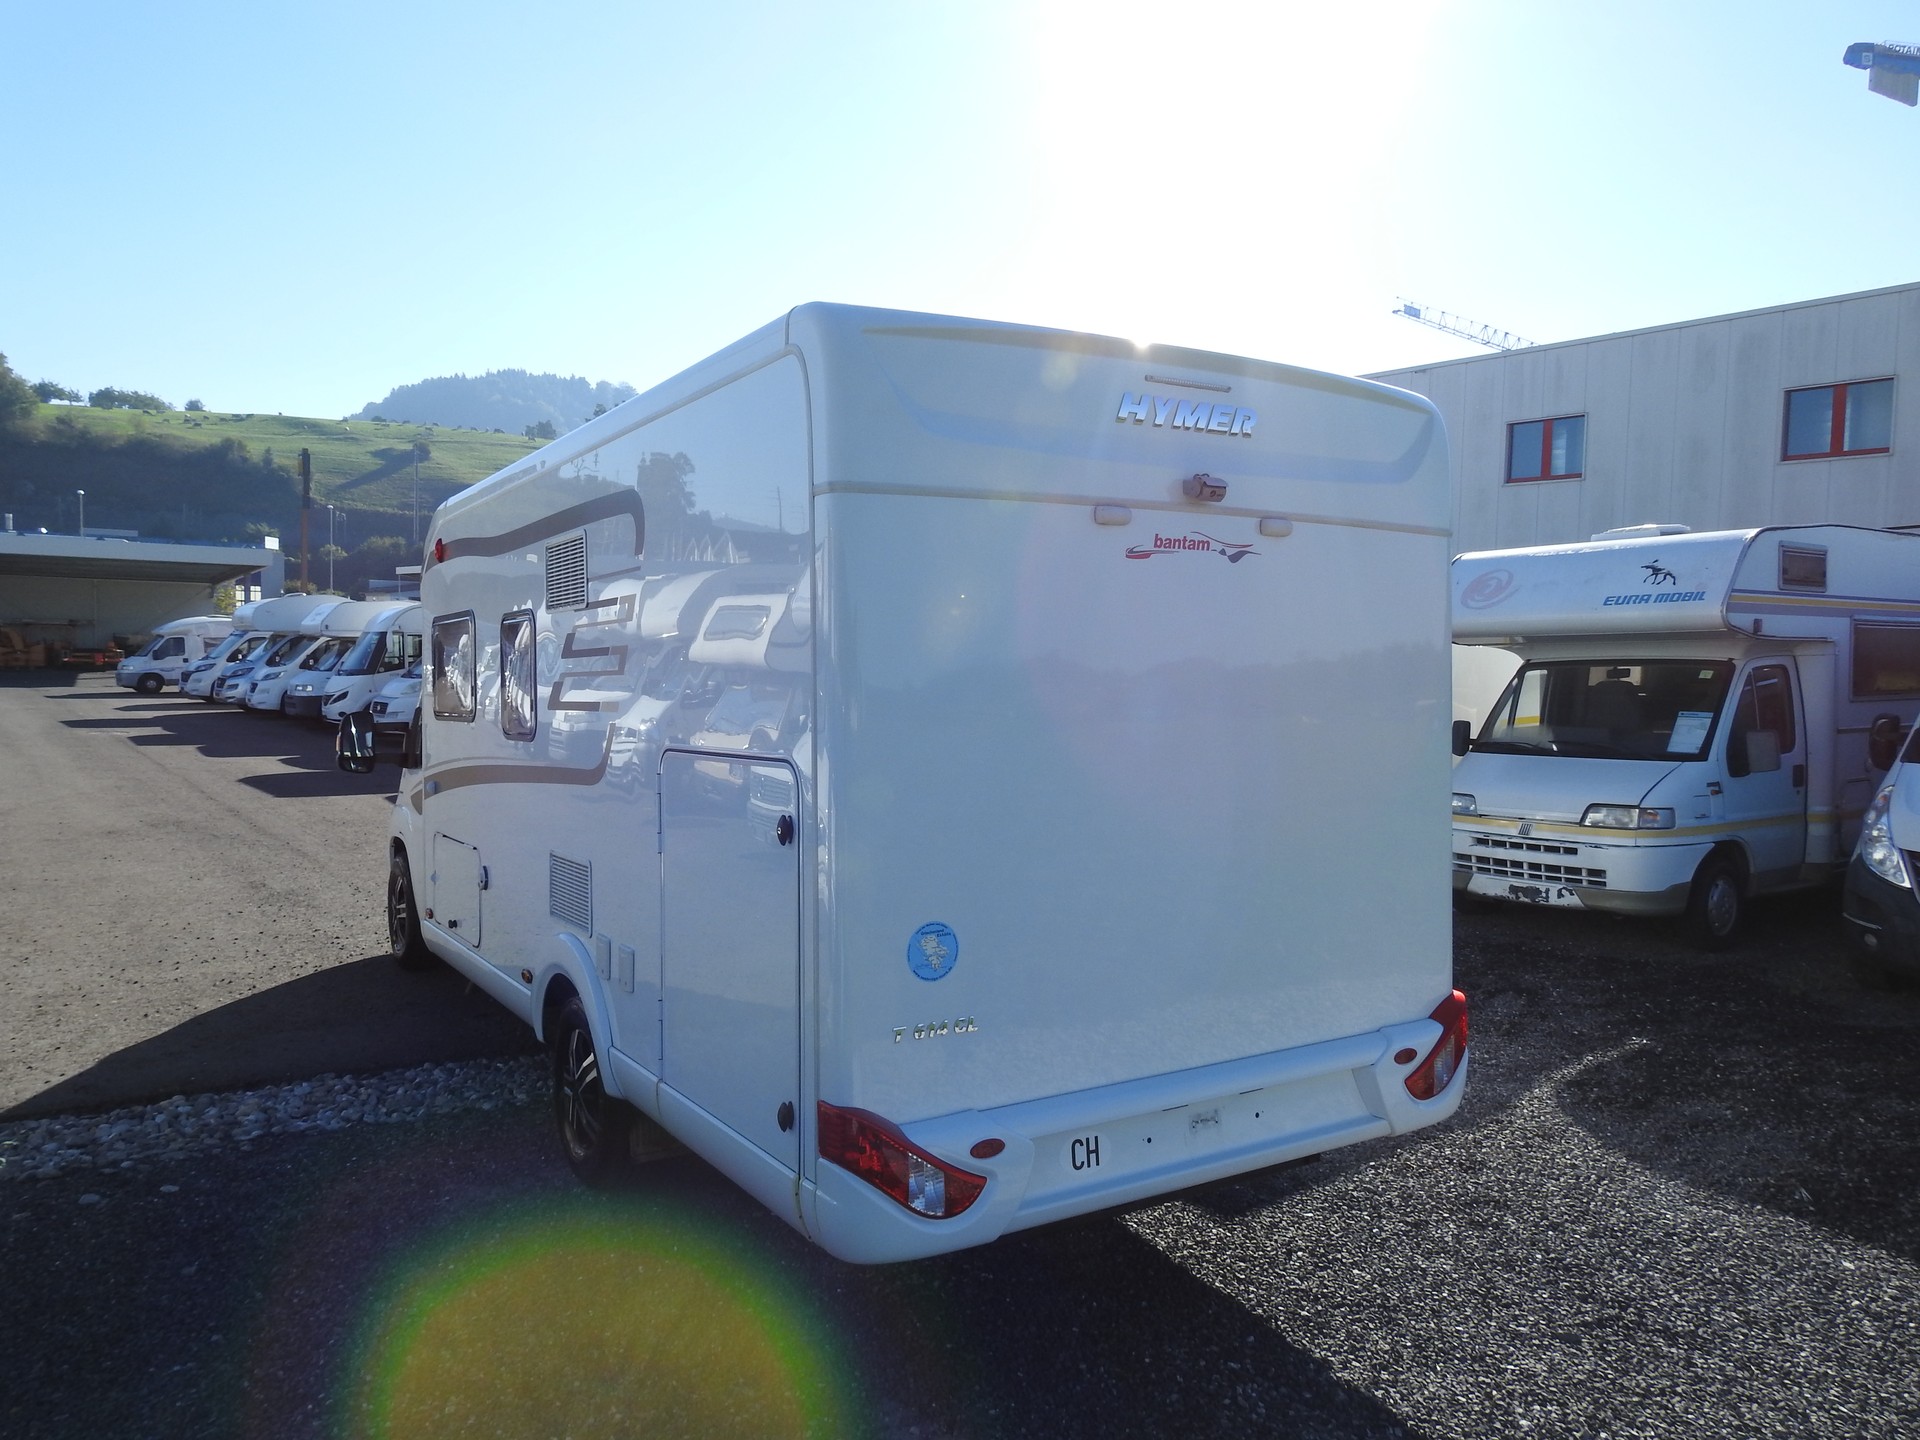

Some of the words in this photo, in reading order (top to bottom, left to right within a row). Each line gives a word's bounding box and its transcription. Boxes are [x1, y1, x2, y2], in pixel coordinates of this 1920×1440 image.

[1115, 391, 1258, 438] HYMER
[1153, 533, 1211, 551] bantam
[1603, 593, 1652, 606] EURA
[1653, 591, 1706, 603] MOBIL
[892, 1026, 907, 1043] T
[913, 1020, 949, 1039] 614
[954, 1015, 979, 1034] CL
[1071, 1135, 1100, 1171] CH
